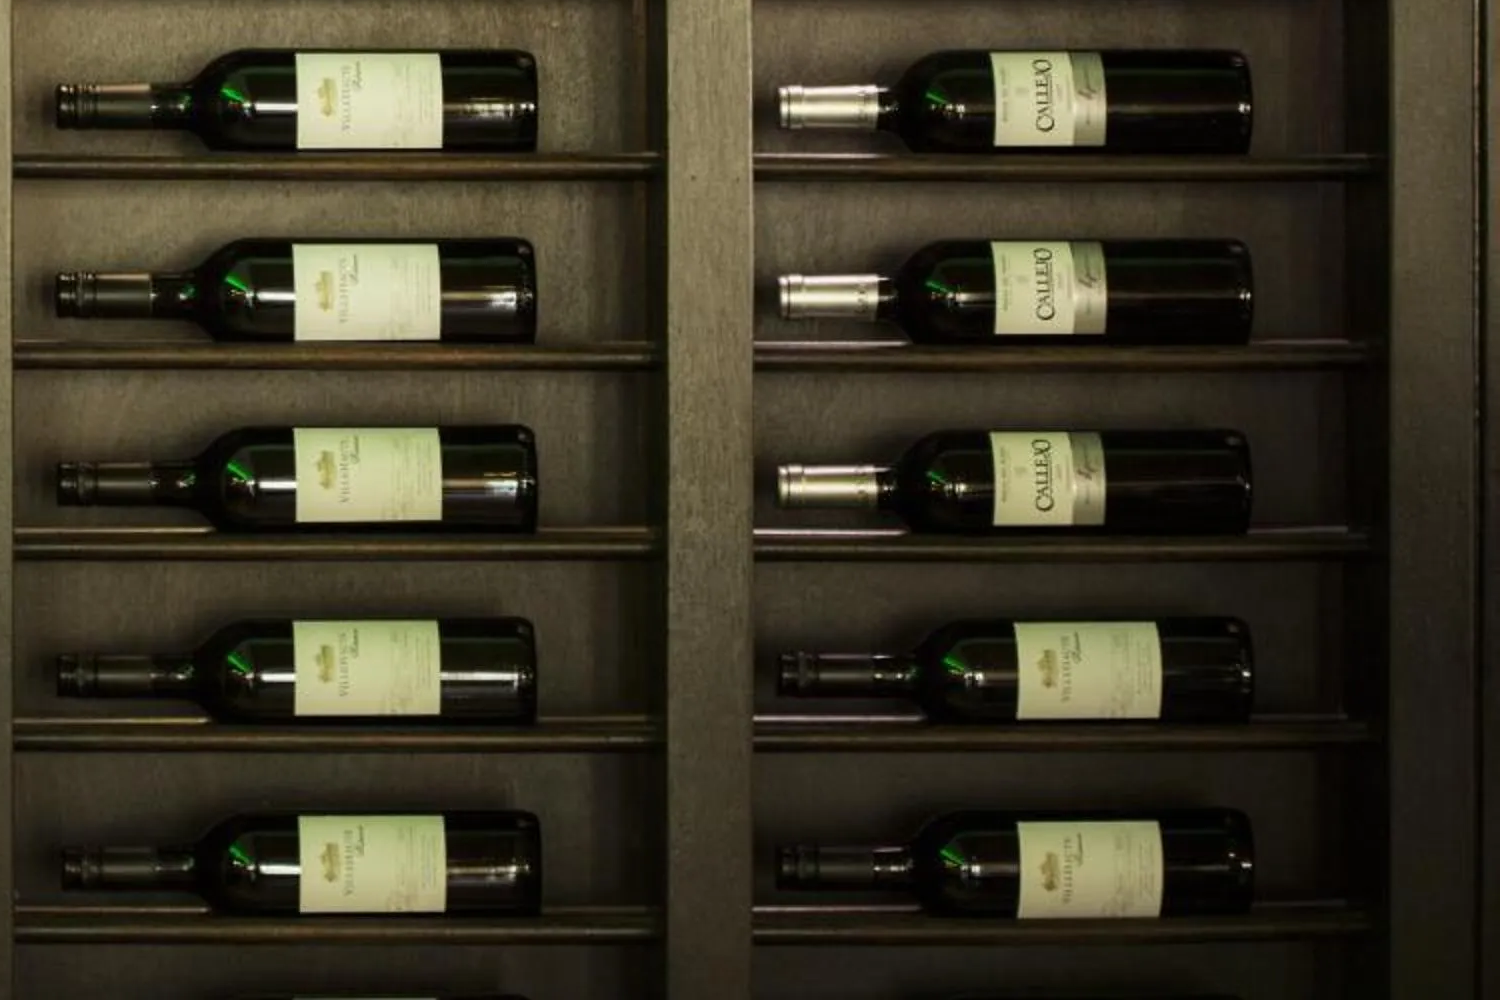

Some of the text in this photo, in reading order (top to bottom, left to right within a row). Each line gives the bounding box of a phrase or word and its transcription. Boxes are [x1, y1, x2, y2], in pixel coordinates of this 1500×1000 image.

[1033, 59, 1055, 133] CALLEJO
[1033, 246, 1055, 321] CALLEJO
[1032, 438, 1055, 513] CALLEJO
